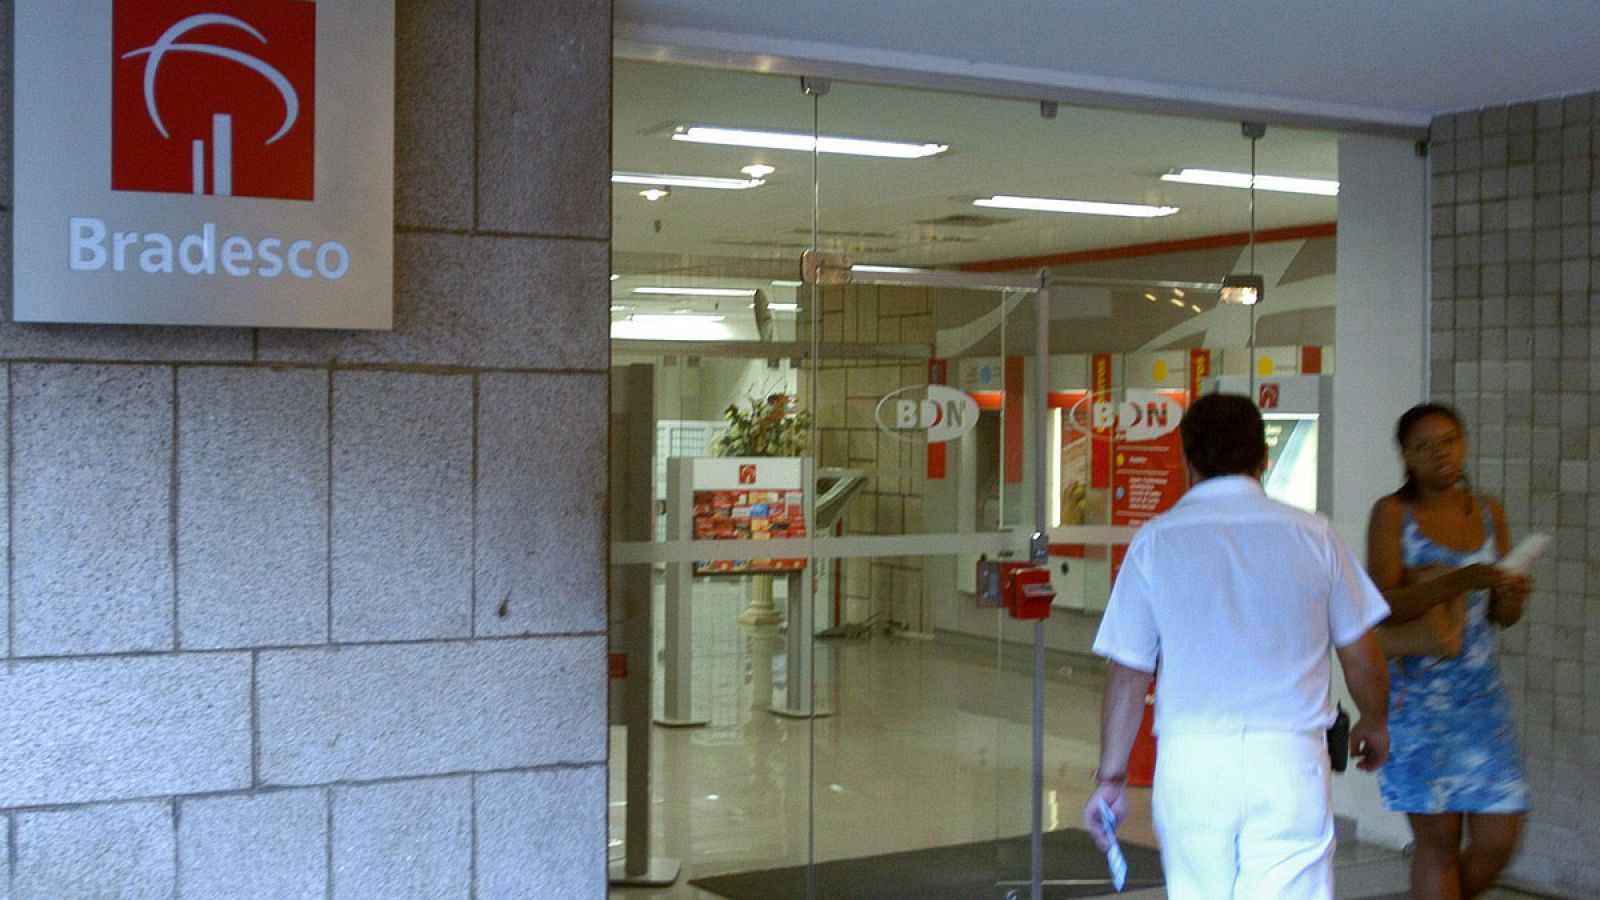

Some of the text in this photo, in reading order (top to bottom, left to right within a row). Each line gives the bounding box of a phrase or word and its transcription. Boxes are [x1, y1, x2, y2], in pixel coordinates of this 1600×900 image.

[69, 217, 350, 281] Bradesco
[896, 399, 965, 428] BDN
[1093, 401, 1168, 428] BDN
